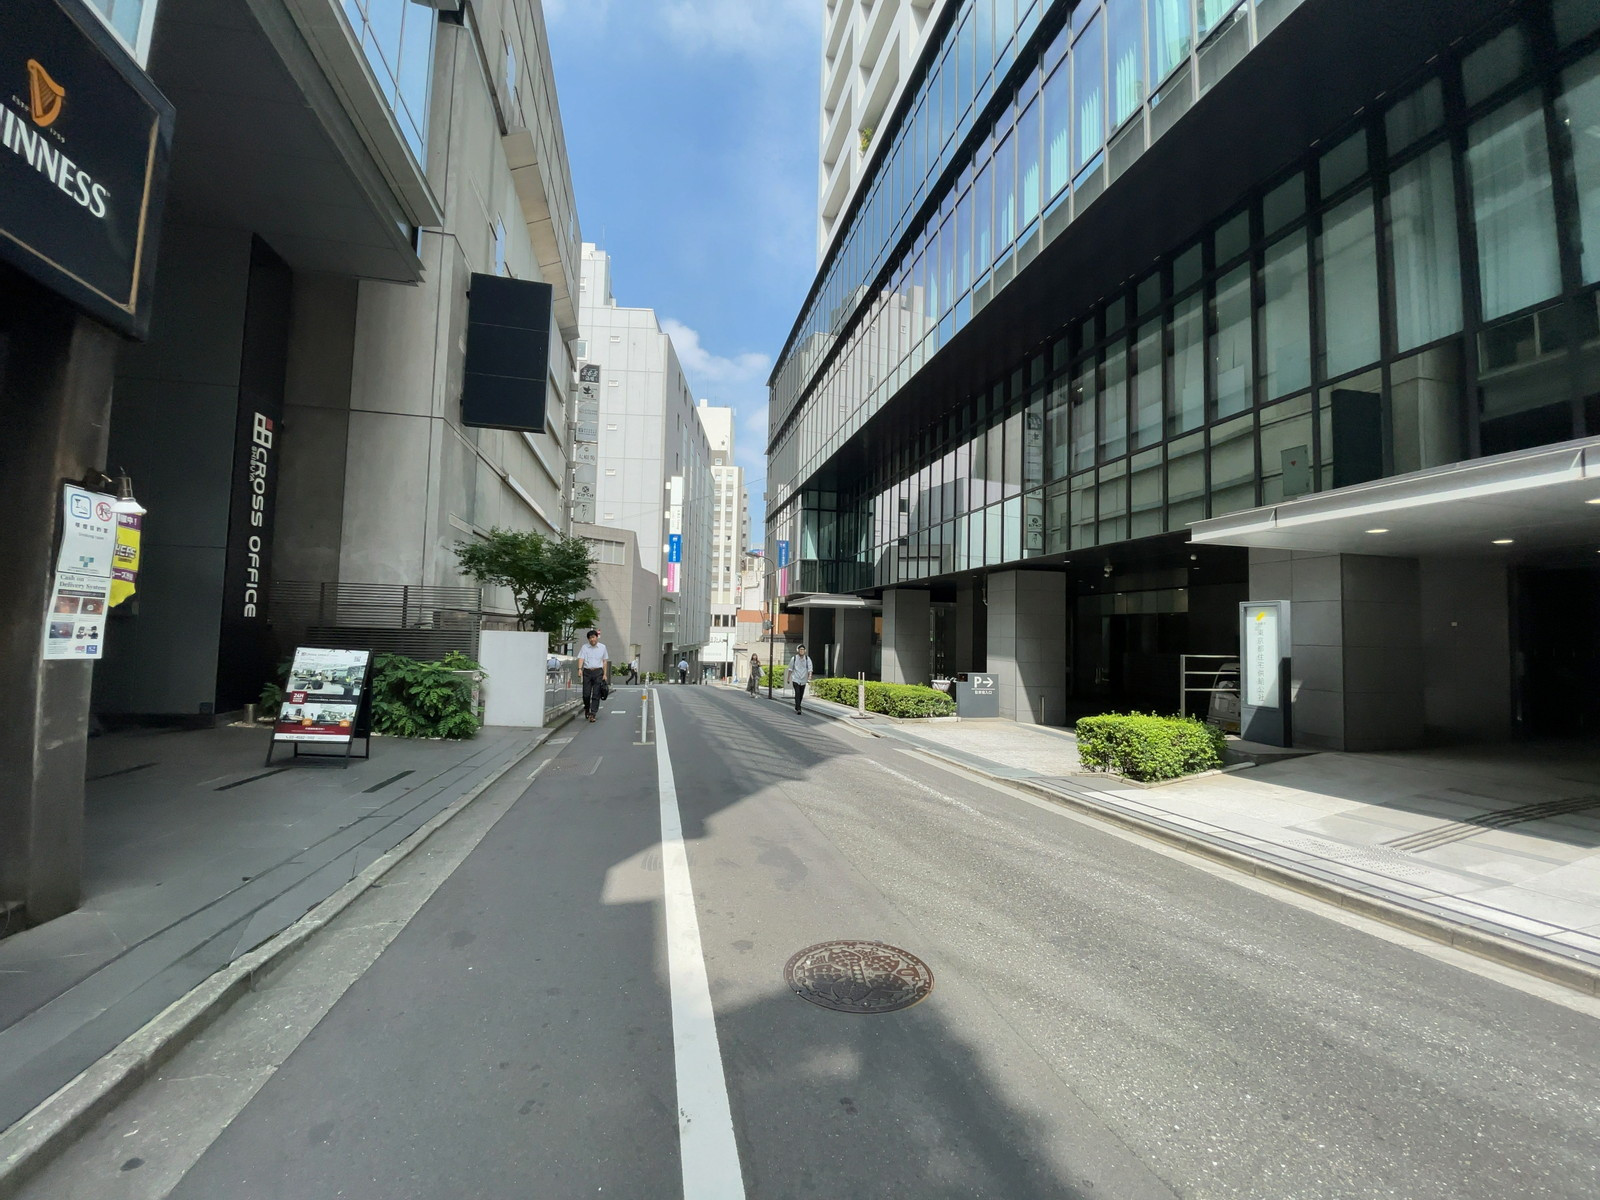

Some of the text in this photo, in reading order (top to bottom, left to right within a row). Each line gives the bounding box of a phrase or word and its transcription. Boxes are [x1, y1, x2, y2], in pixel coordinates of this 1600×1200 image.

[248, 446, 257, 482] SHIBUYA
[243, 447, 267, 618] CROSS OFFICE
[60, 581, 106, 592] Delivery System
[974, 676, 982, 688] P
